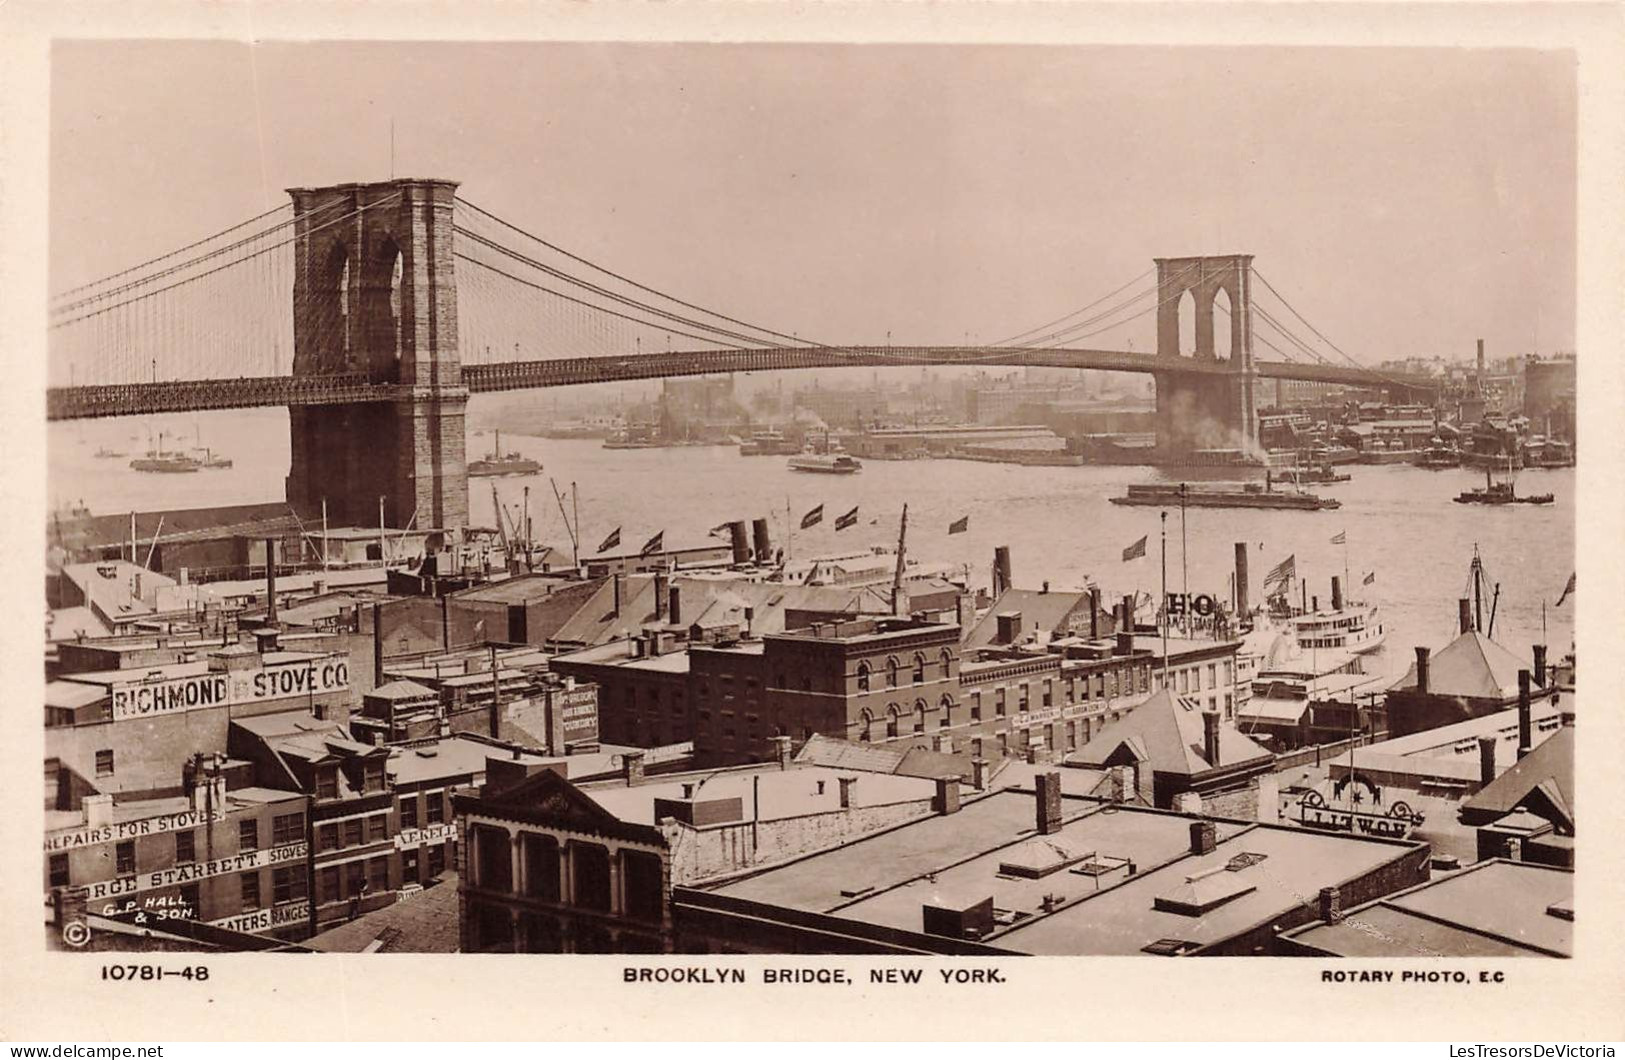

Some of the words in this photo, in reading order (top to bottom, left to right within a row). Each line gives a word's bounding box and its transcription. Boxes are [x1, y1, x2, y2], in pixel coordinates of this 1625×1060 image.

[115, 679, 227, 716] RICHMOND
[254, 667, 317, 697] STOVE
[118, 822, 149, 837] FOR
[270, 845, 309, 862] STOVES
[271, 905, 310, 925] RANGES
